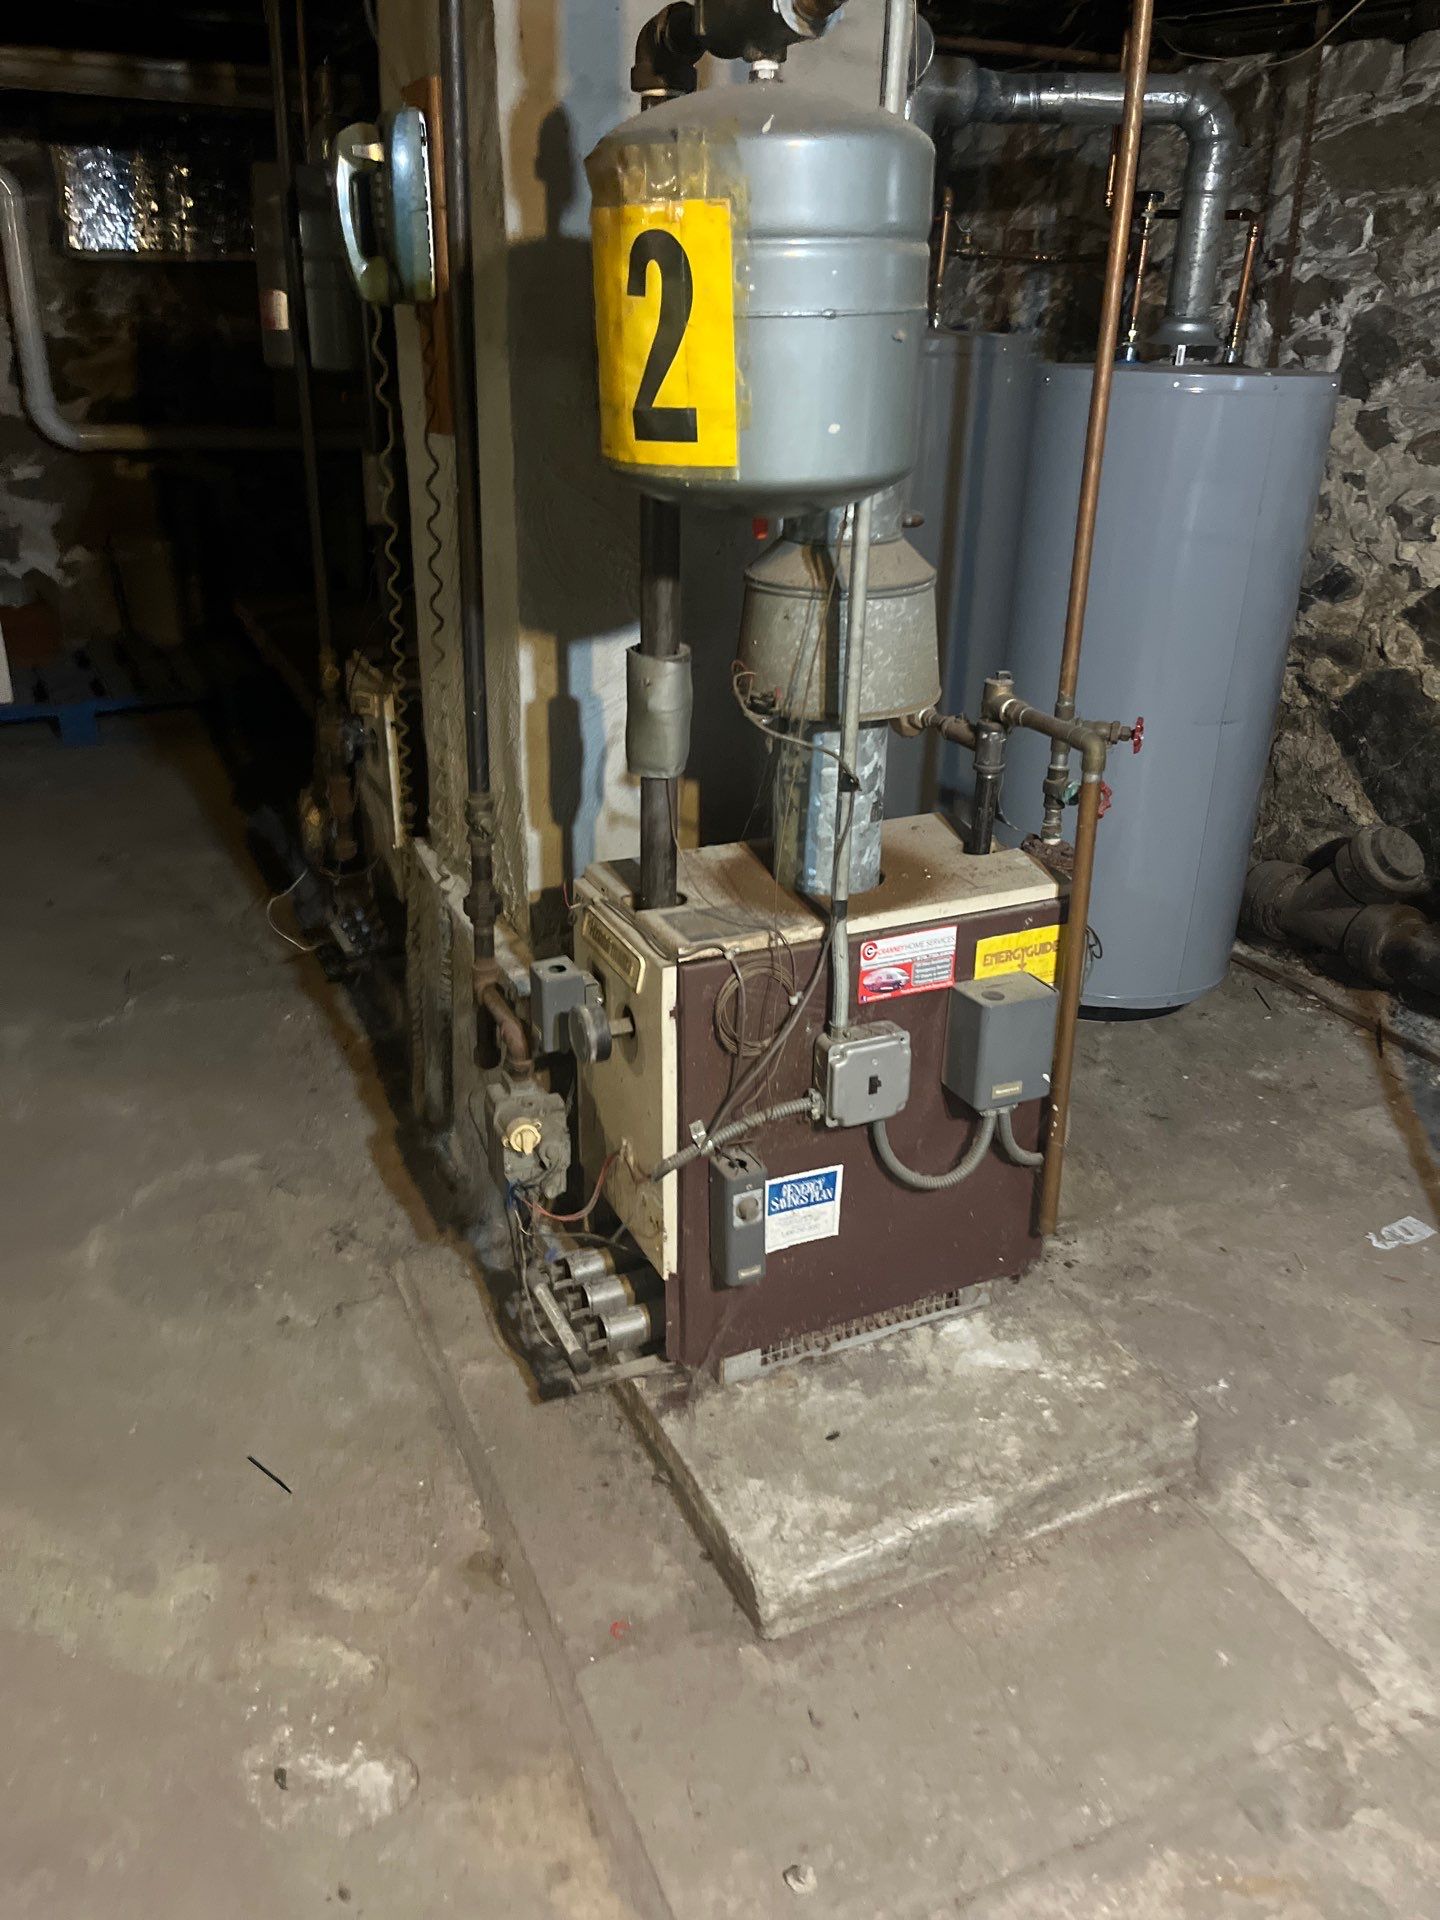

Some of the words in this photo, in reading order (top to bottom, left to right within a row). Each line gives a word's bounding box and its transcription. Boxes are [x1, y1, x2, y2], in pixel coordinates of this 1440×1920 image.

[627, 229, 698, 443] 2
[905, 940, 926, 950] HOME
[926, 935, 955, 947] SERVICES
[810, 1187, 834, 1203] PLAN
